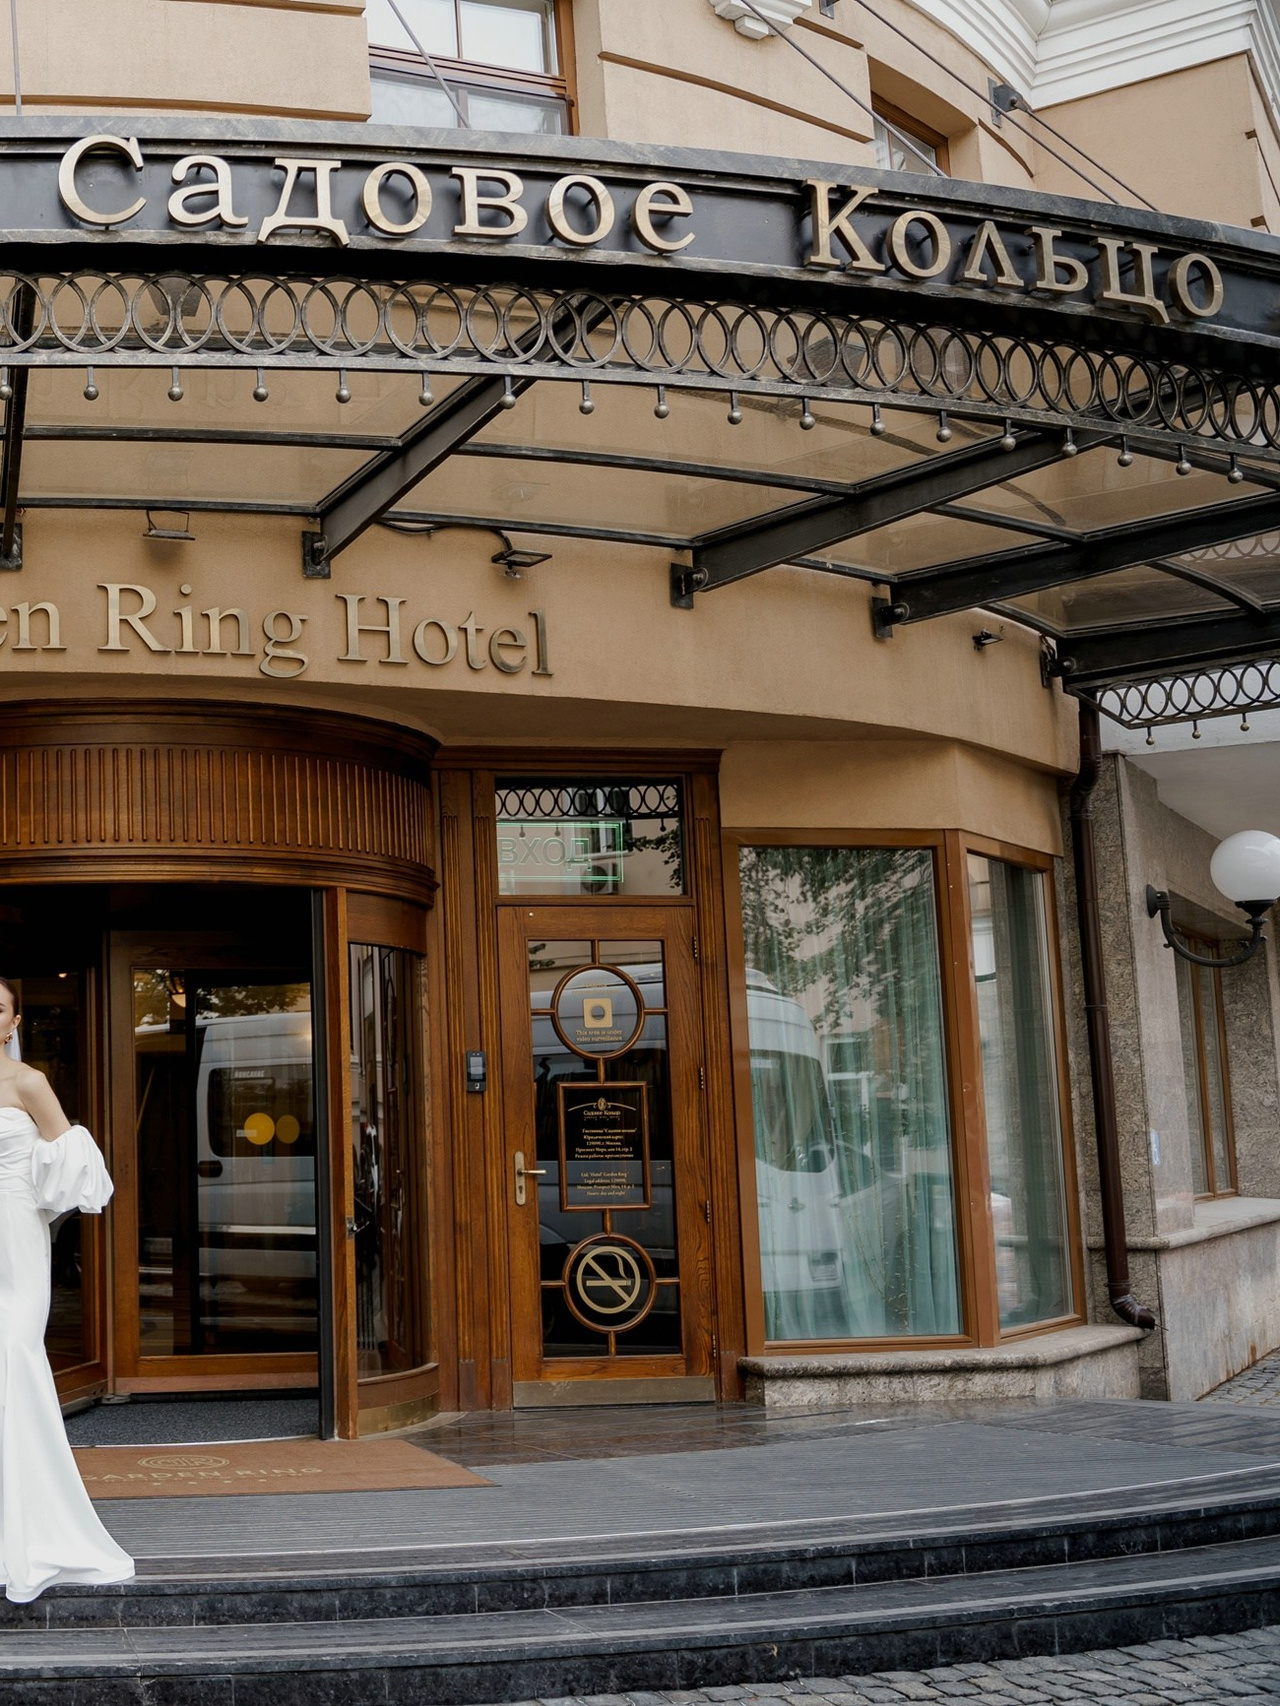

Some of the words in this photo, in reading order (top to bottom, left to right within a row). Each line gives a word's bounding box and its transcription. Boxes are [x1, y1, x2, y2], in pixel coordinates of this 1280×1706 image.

[58, 134, 697, 253] Садовое
[804, 179, 1226, 325] Кольцо
[97, 582, 309, 678] Ring
[336, 593, 554, 677] Hotel
[497, 837, 592, 871] ВХОД
[235, 1467, 323, 1476] RING
